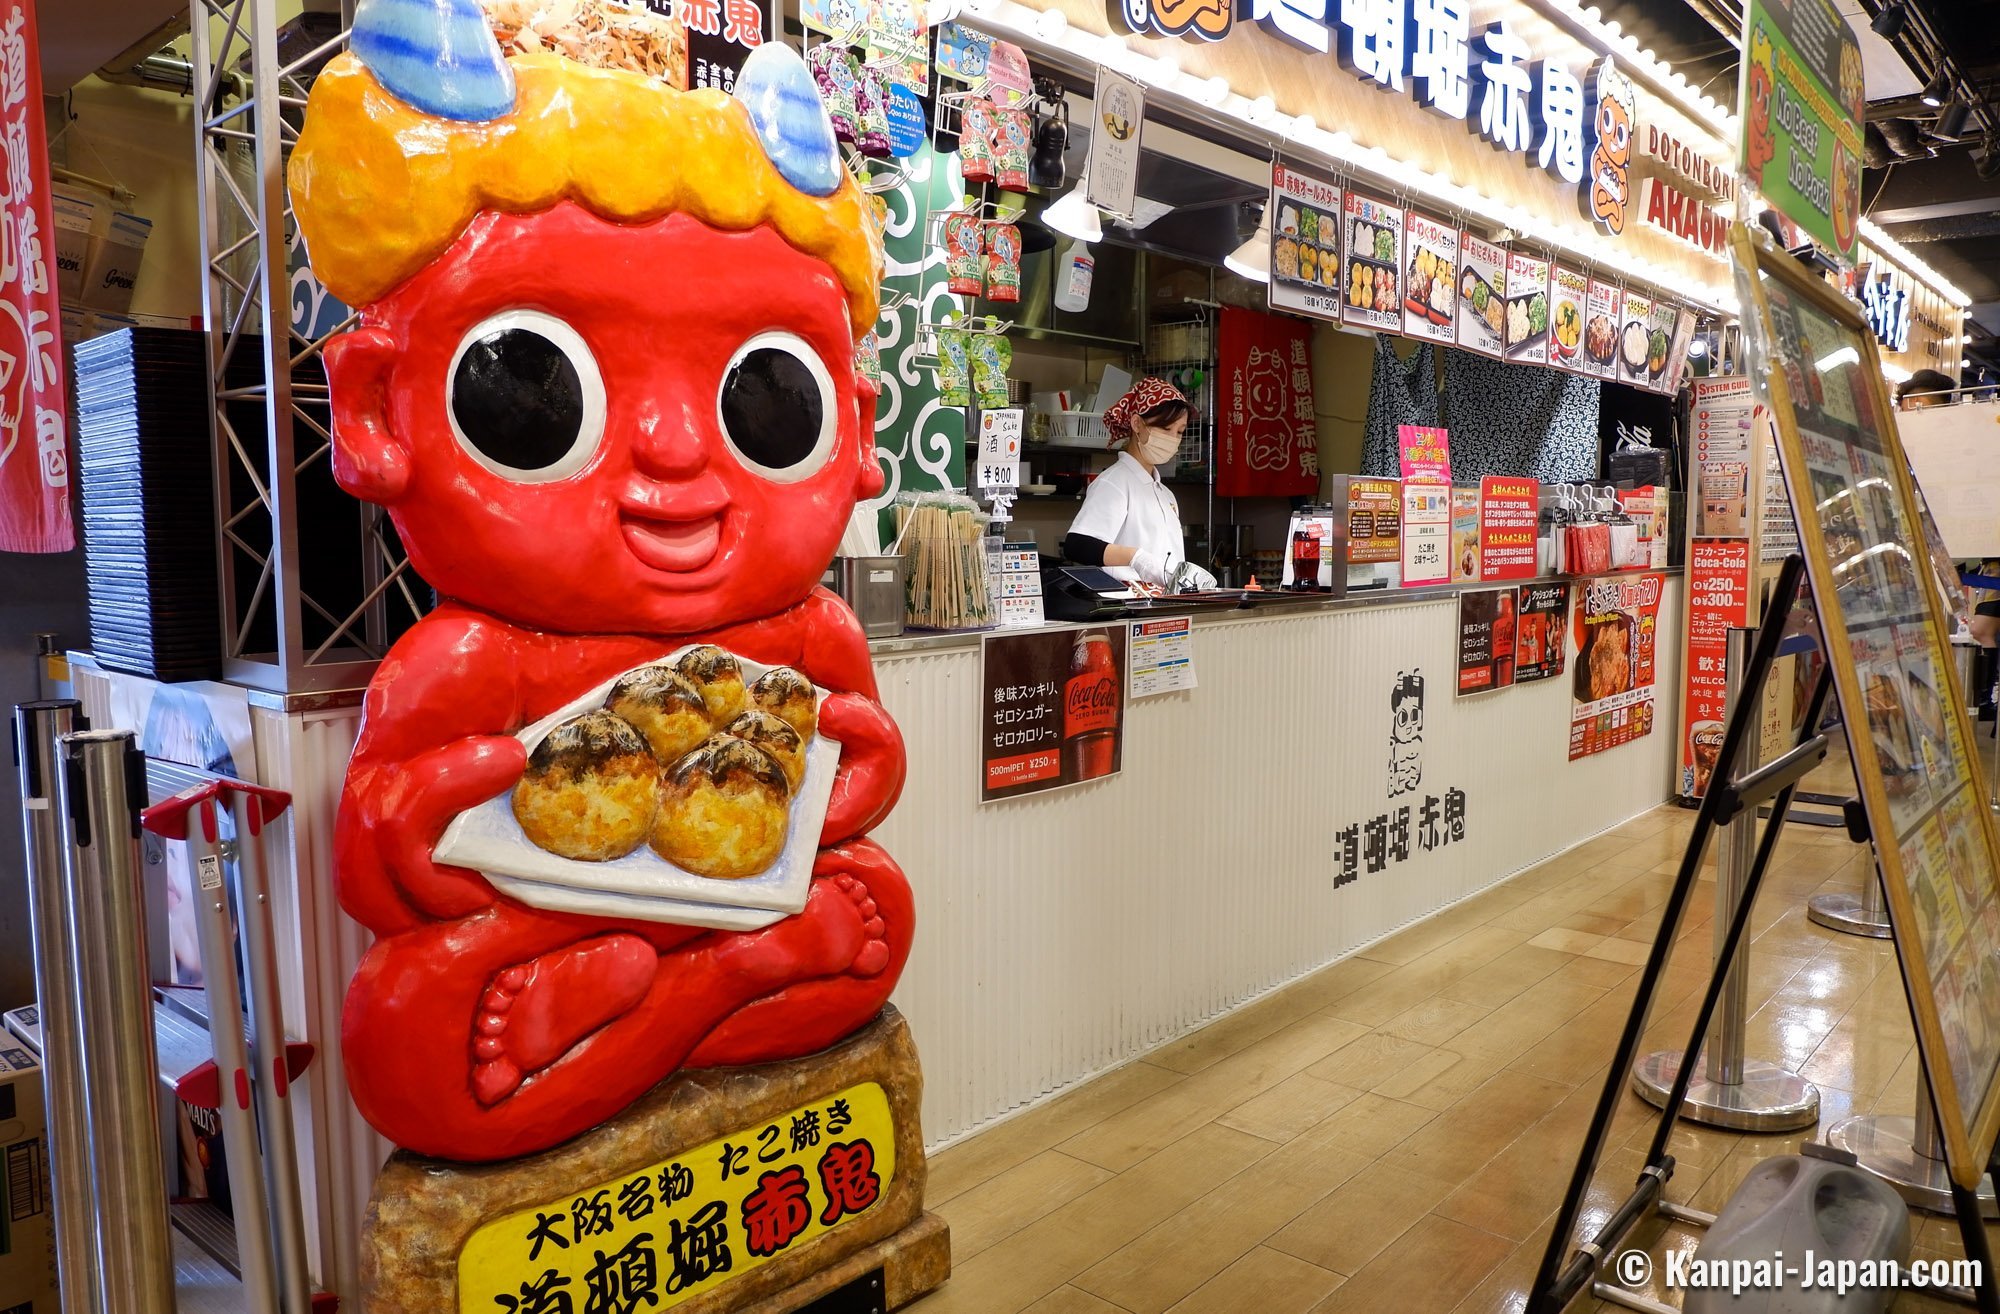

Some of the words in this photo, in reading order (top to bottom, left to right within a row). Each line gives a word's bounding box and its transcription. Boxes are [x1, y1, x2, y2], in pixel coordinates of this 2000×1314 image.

[1649, 124, 1735, 201] DOTONBORI
[1647, 177, 1731, 254] AKAON
[1233, 366, 1244, 426] 大阪名物
[1699, 382, 1730, 396] SYSTEM
[1290, 338, 1318, 477] 道頓堀赤鬼
[986, 435, 998, 454] 酒
[1695, 547, 1745, 556] コカ・コーラ
[1694, 557, 1746, 568] Coca-Cola
[1691, 676, 1726, 686] WELCO
[994, 681, 1058, 704] 後味スッキリ、
[993, 705, 1053, 725] ゼロシュガー
[993, 727, 1059, 748] ゼロカロリー。
[990, 762, 1025, 776] 500mlPET
[527, 1161, 694, 1260] 大阪名物
[719, 1099, 853, 1182] たこ焼き
